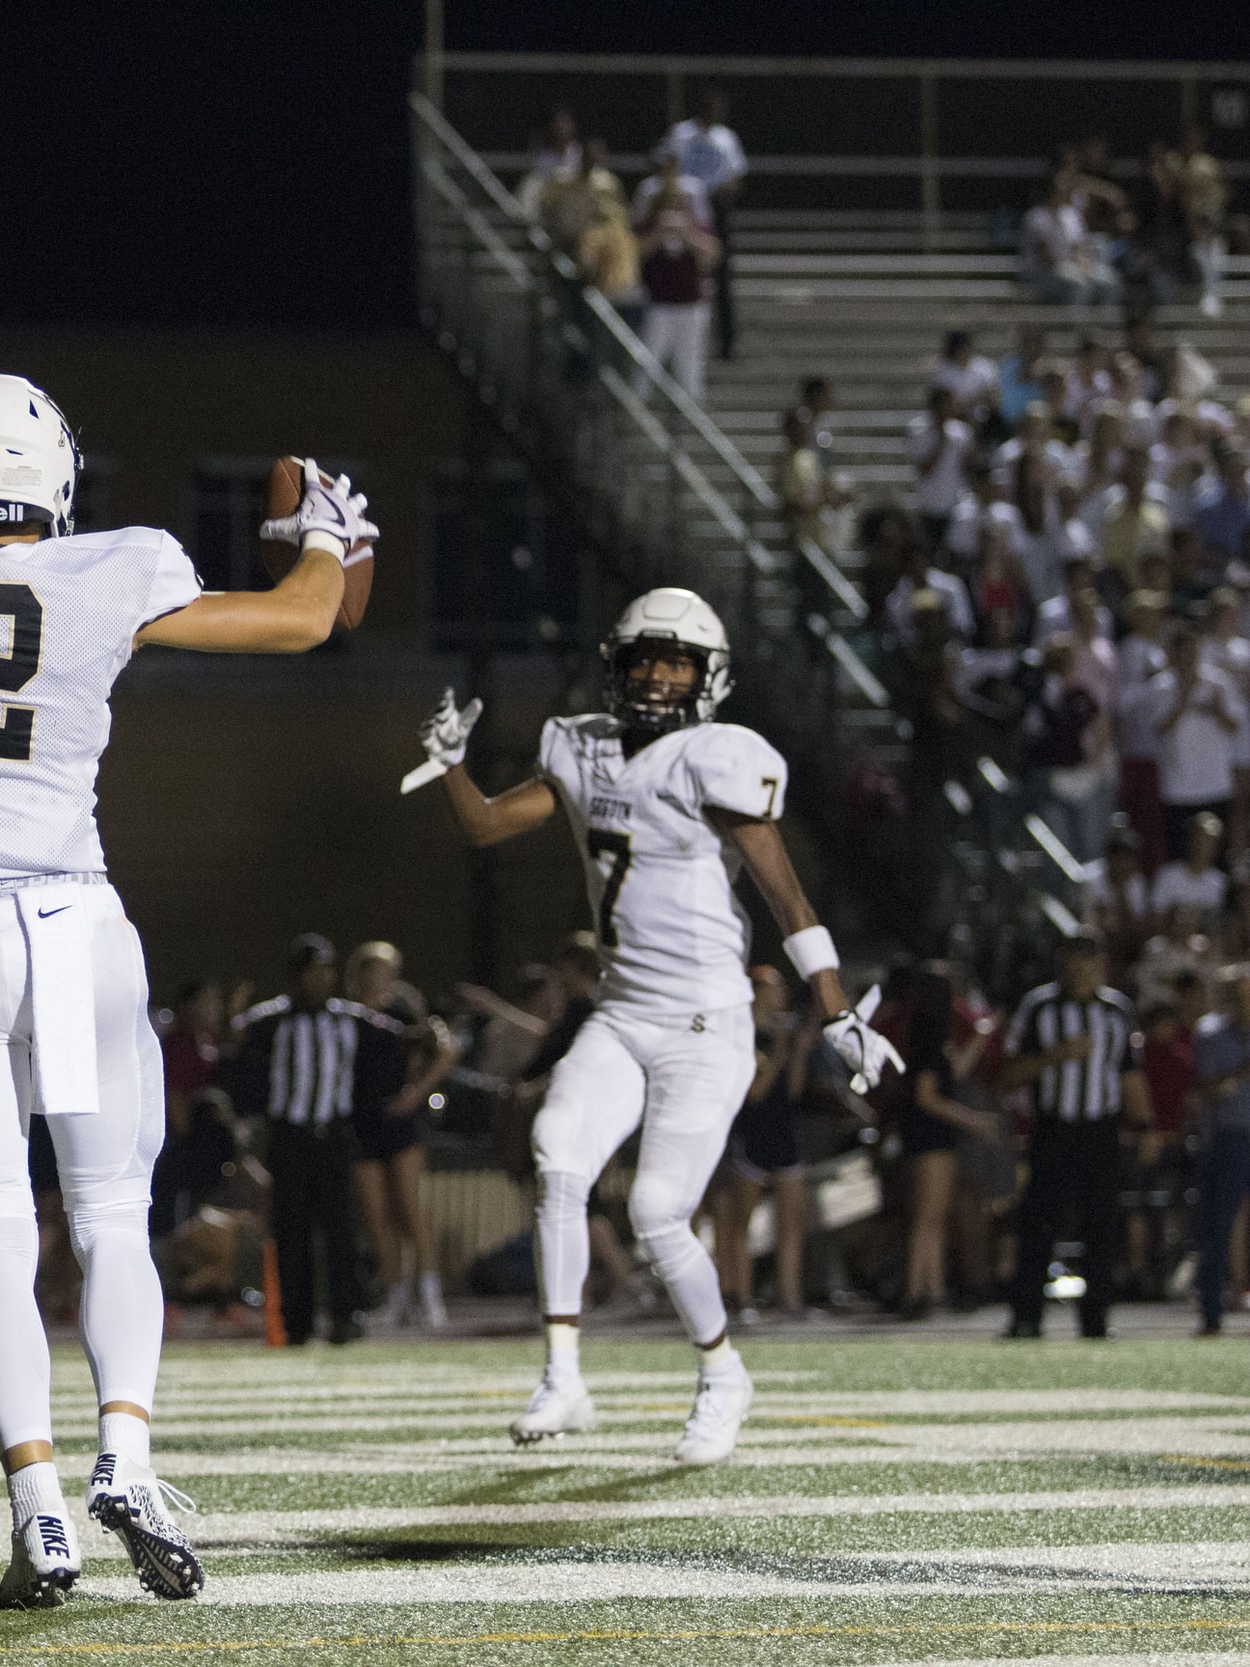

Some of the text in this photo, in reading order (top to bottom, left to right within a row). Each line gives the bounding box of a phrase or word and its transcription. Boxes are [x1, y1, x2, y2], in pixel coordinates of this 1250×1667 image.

[760, 775, 779, 822] 7
[586, 827, 634, 950] 7
[91, 1453, 117, 1487] NIKE
[37, 1515, 70, 1560] NIKE
